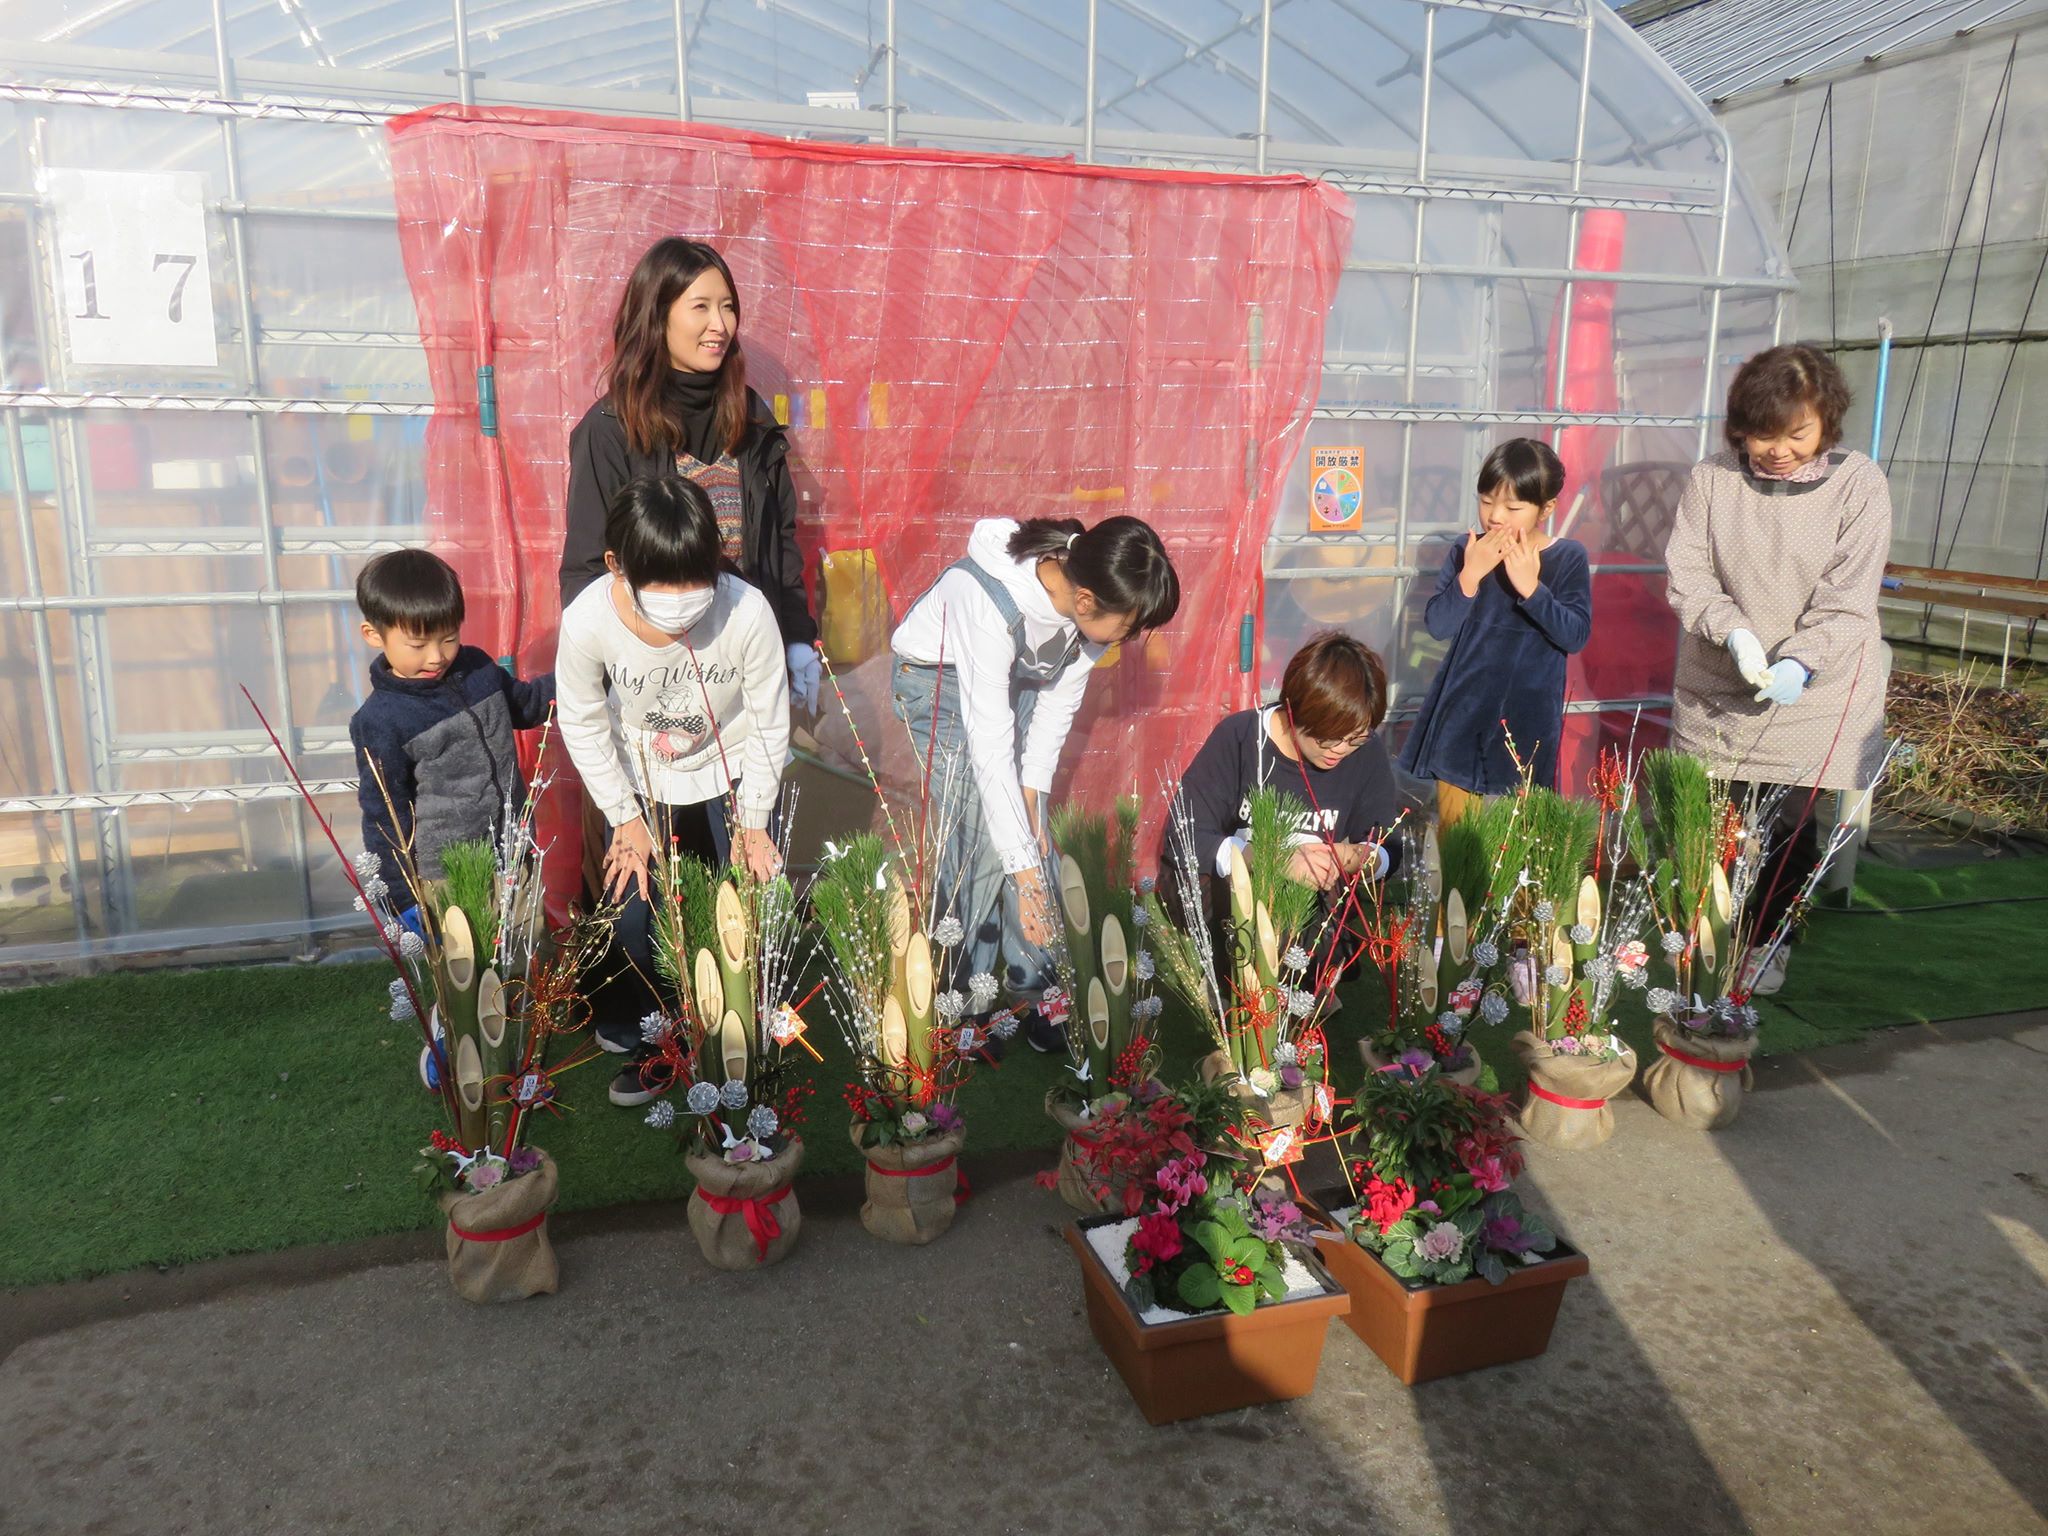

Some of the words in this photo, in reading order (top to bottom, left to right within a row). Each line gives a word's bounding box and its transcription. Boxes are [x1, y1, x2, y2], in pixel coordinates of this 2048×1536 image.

[1315, 456, 1360, 467] 開放厳禁
[609, 662, 645, 696] My
[1238, 797, 1339, 832] BLYN
